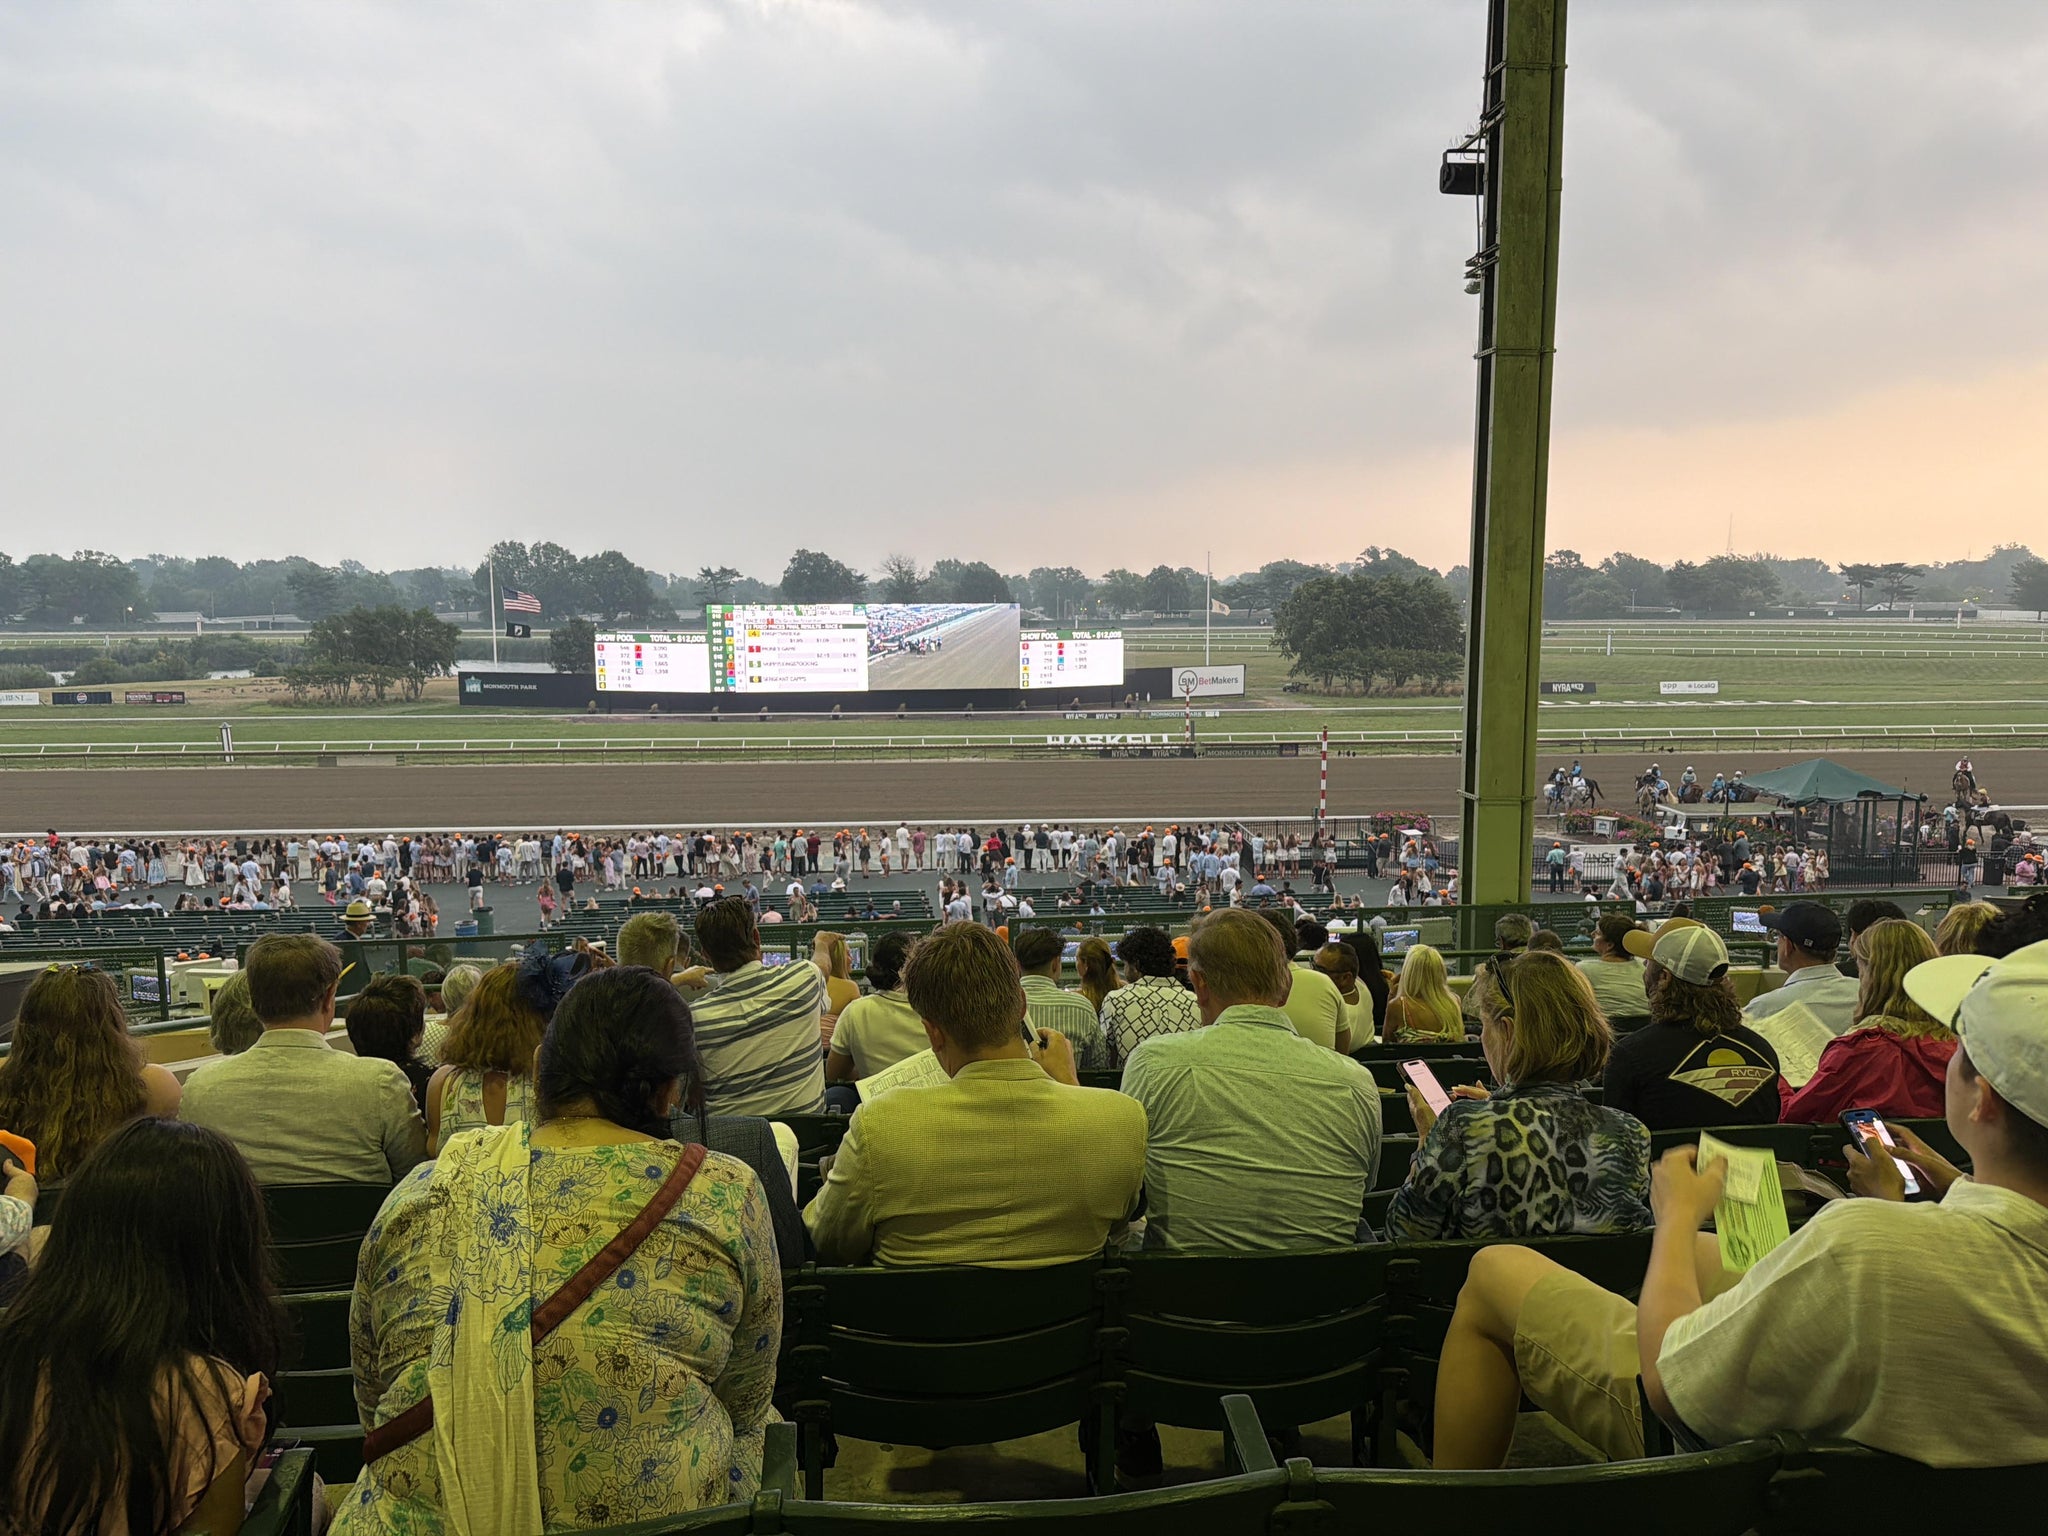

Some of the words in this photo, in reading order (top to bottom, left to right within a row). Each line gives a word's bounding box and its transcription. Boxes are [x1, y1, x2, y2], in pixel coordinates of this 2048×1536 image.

[595, 634, 615, 642] SHOW
[616, 634, 635, 642] POOL
[650, 634, 671, 642] TOTAL
[1021, 632, 1040, 640] SHOW
[1041, 632, 1059, 640] POOL
[1199, 676, 1239, 686] BetMakers
[1552, 683, 1572, 692] NYRA
[1111, 750, 1129, 758] NYRA
[1152, 750, 1170, 758] NYRA
[1207, 749, 1256, 757] MONMOUTH
[1731, 1069, 1762, 1077] RVCA
